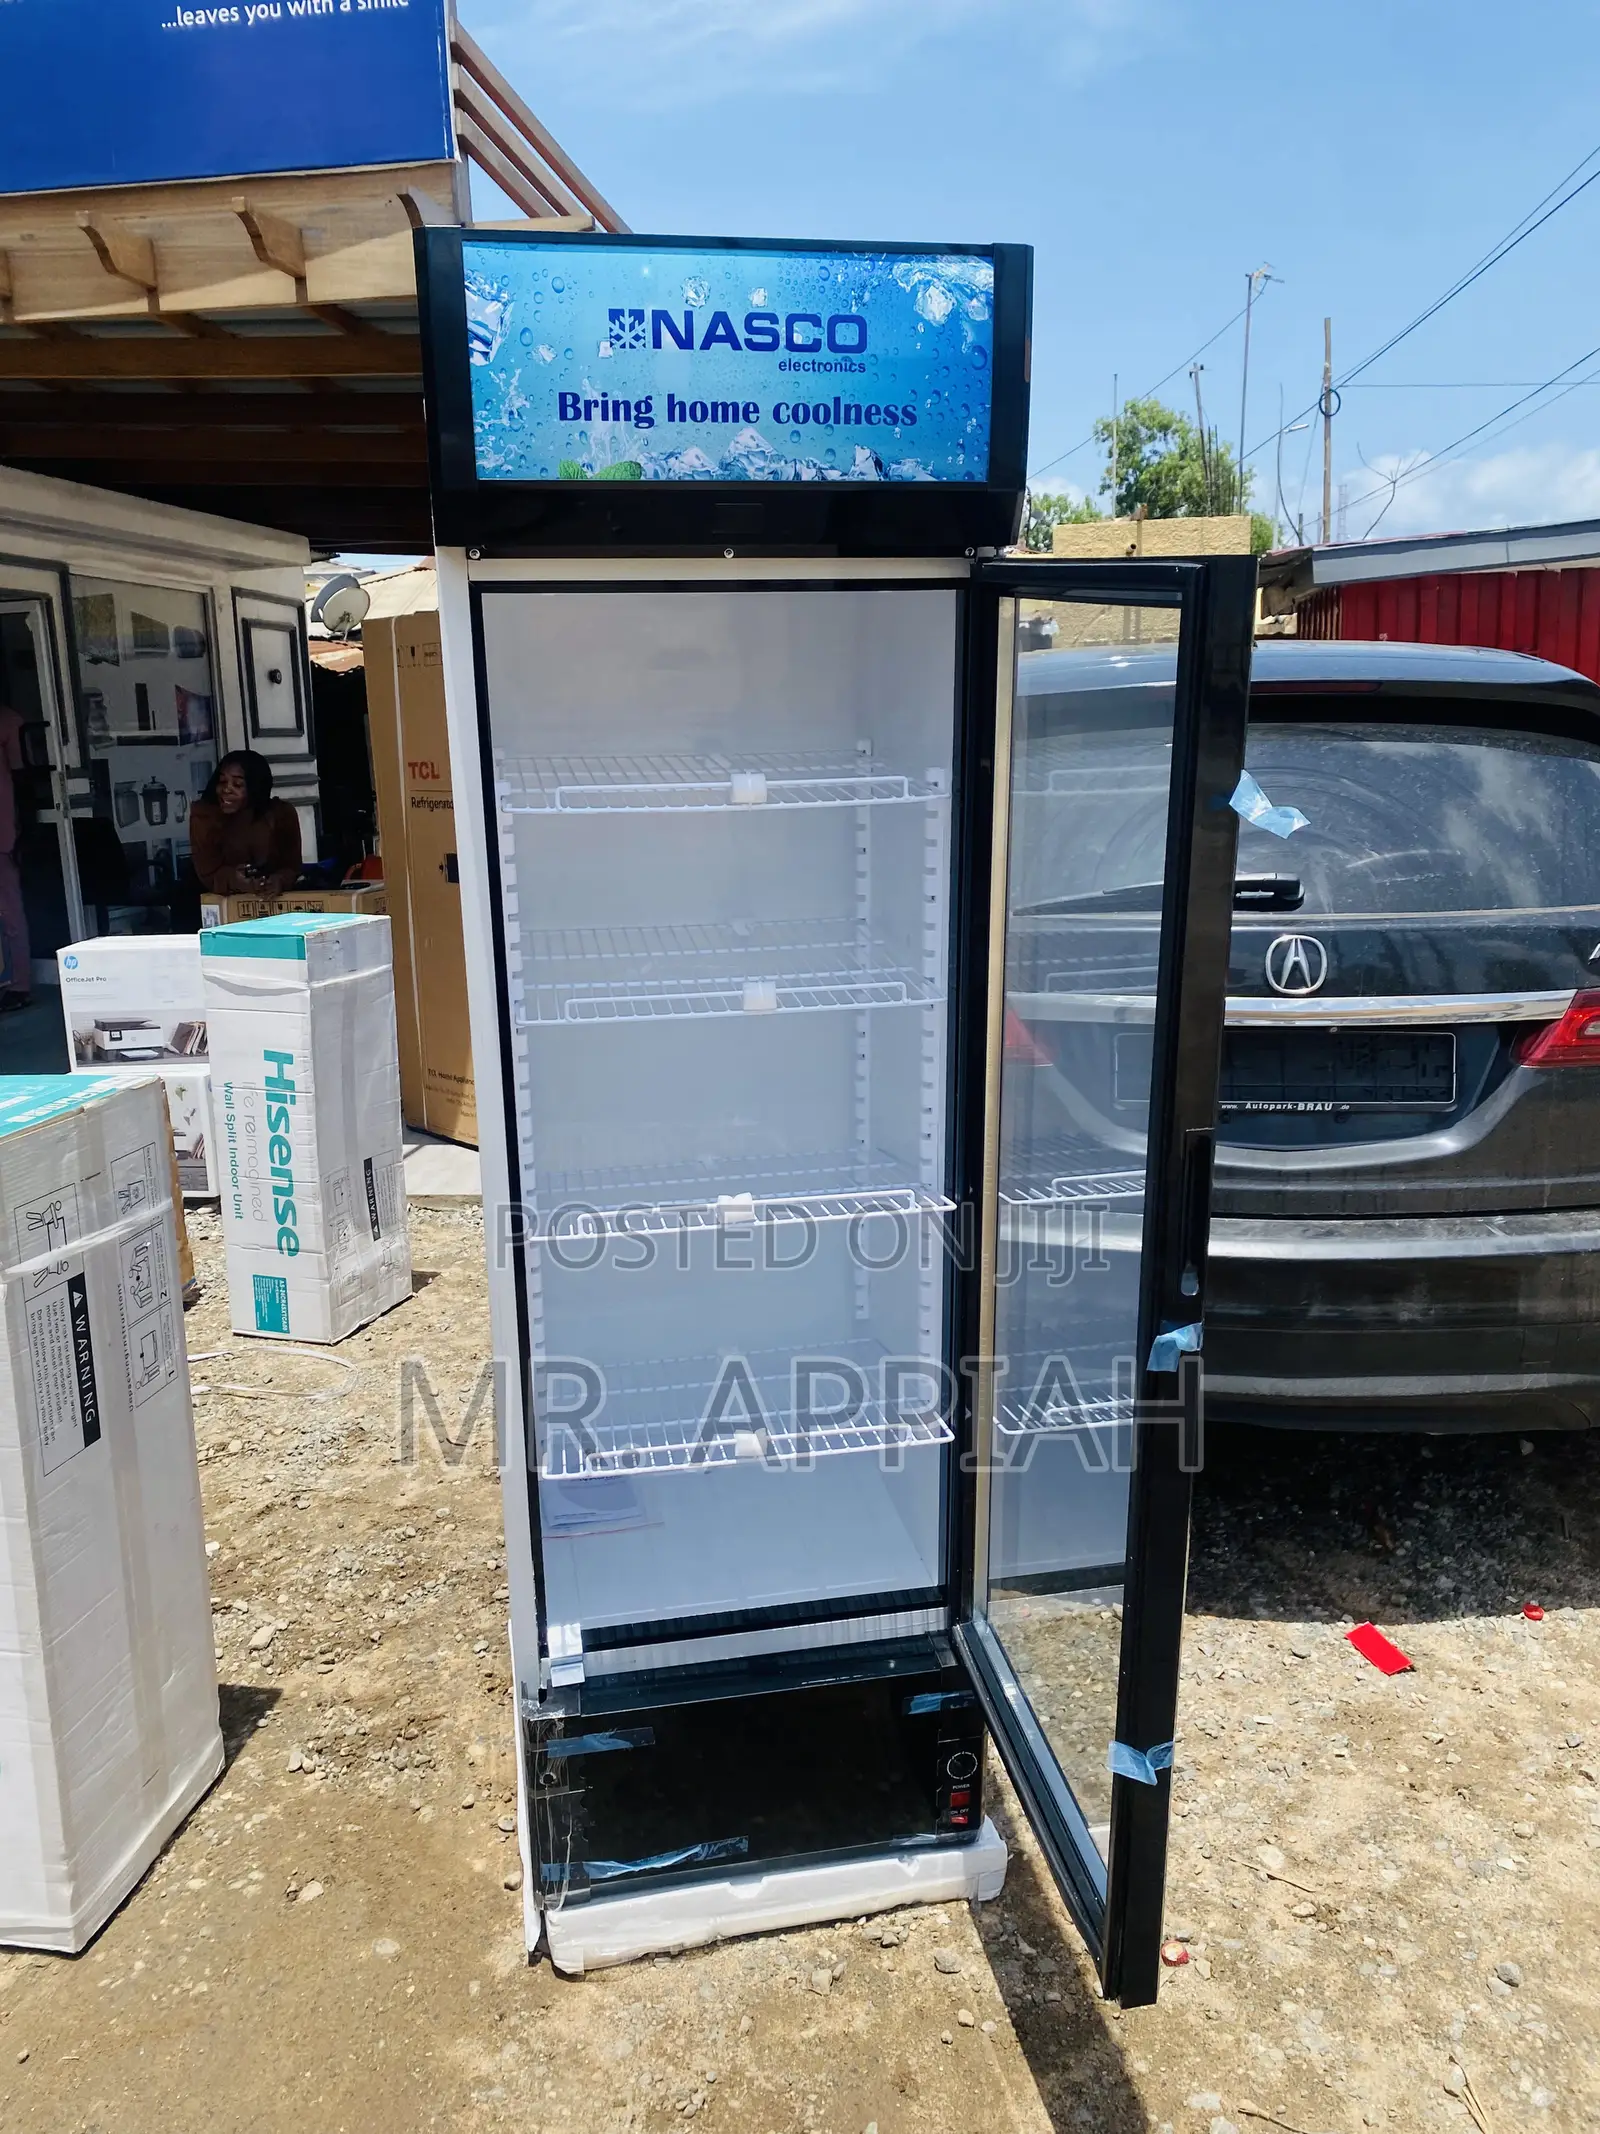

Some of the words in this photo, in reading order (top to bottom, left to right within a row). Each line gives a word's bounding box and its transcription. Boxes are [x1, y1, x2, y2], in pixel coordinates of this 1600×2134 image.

[161, 6, 239, 28] ...leaves
[245, 4, 282, 25] you
[288, 0, 333, 15] with
[340, 0, 351, 12] a
[651, 309, 868, 354] NASCO
[778, 358, 867, 374] electronics
[557, 391, 656, 429] Bring
[666, 393, 760, 424] home
[772, 396, 919, 427] coolness
[408, 762, 440, 780] TCL
[64, 956, 78, 970] hp
[223, 1081, 234, 1109] Wall
[225, 1113, 238, 1143] Split
[228, 1144, 240, 1192] Indoor
[243, 1113, 268, 1223] reimagined
[263, 1049, 300, 1257] Hisense
[233, 1193, 244, 1220] Unit
[364, 1169, 377, 1222] WARNING
[75, 1314, 96, 1423] WARNING
